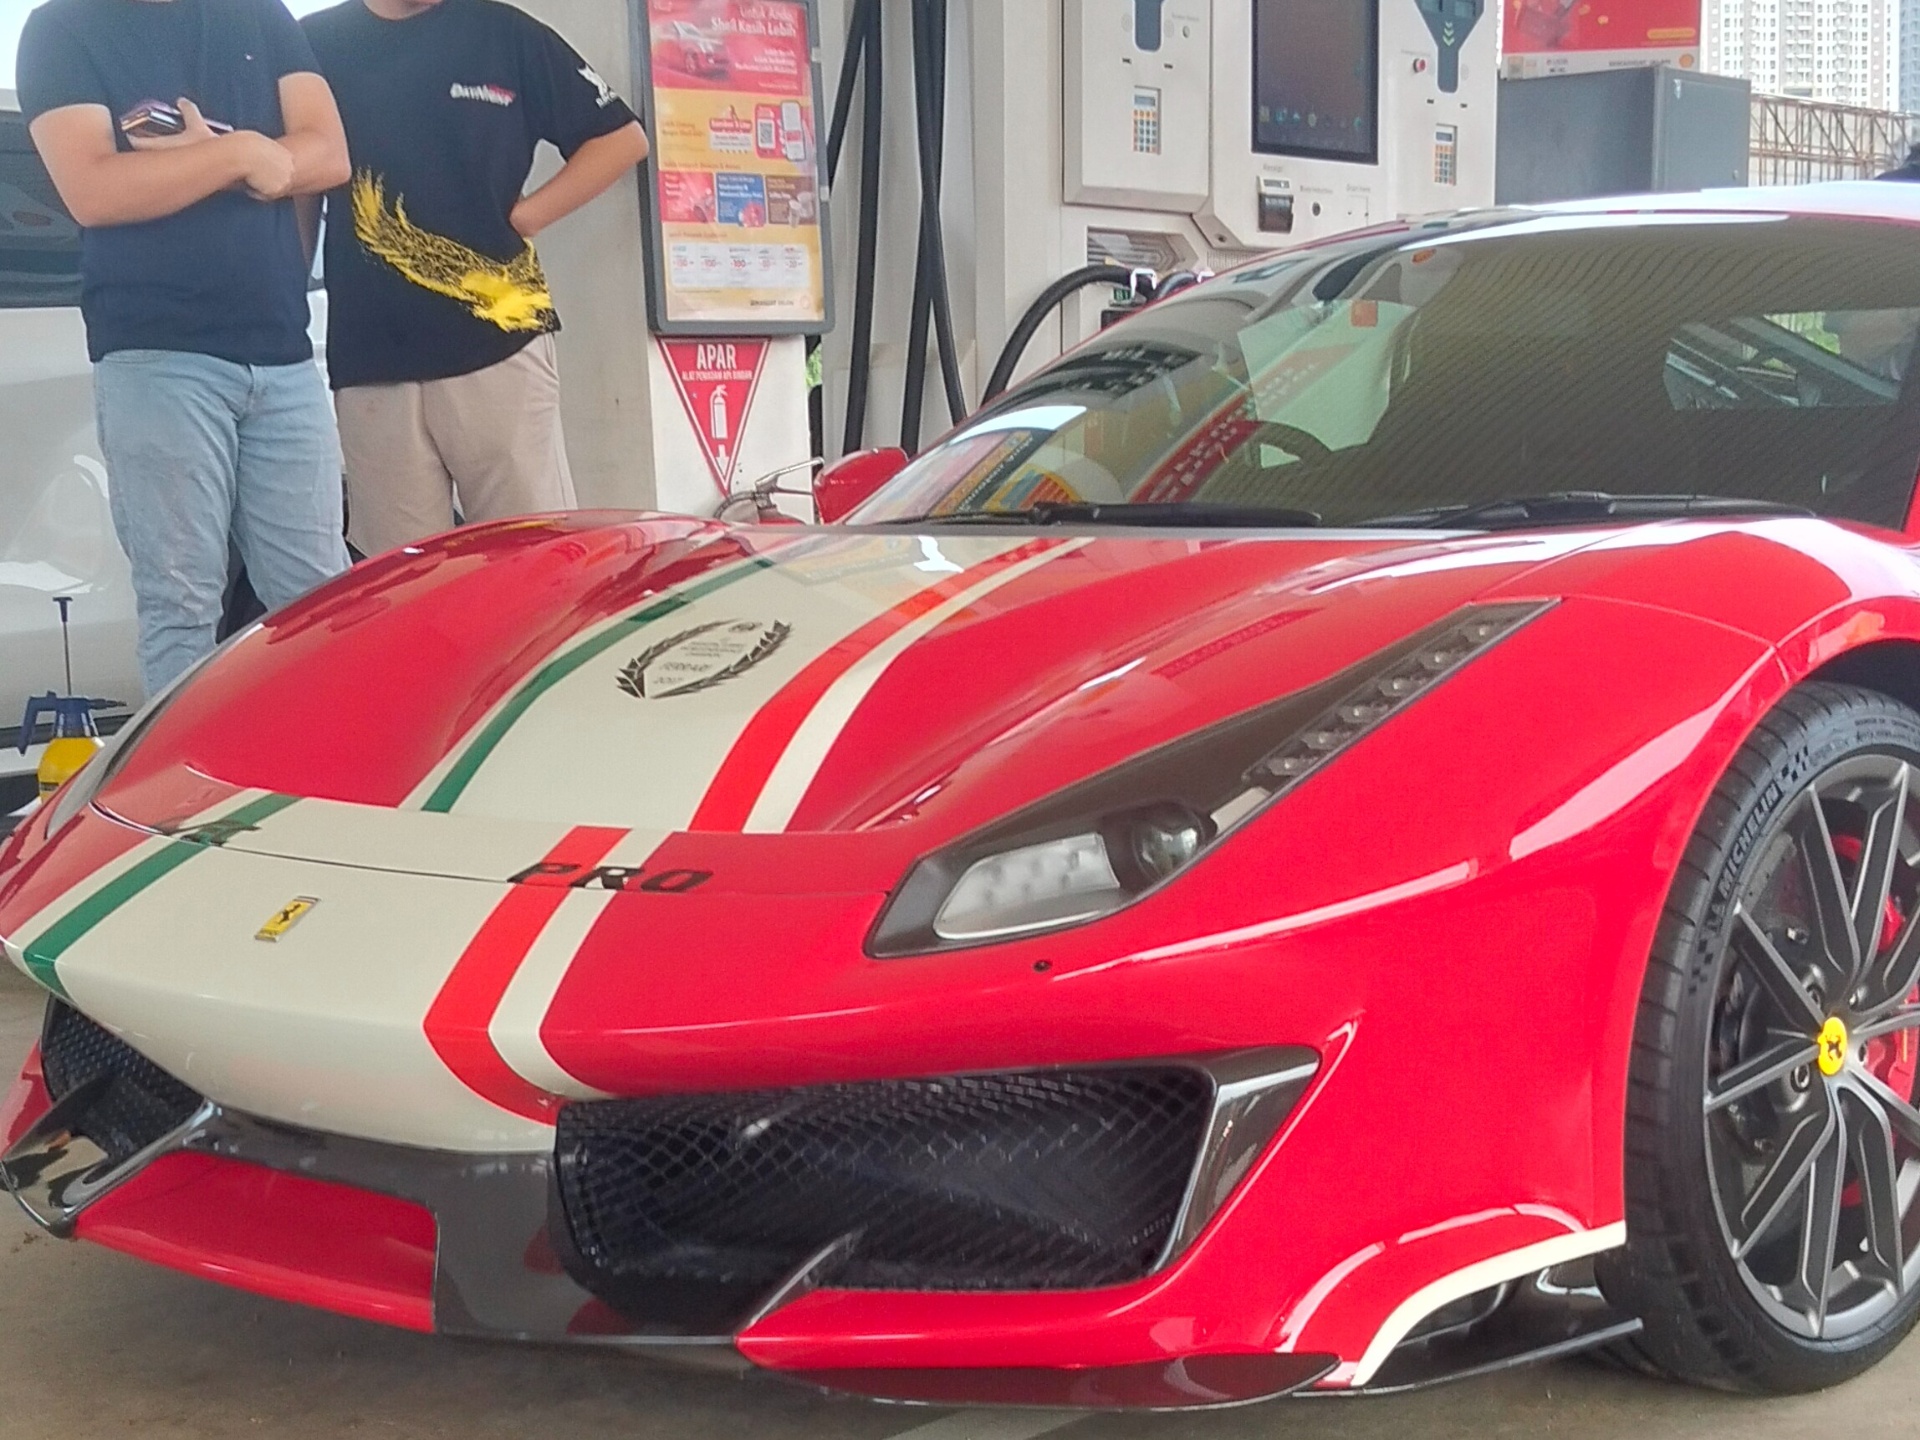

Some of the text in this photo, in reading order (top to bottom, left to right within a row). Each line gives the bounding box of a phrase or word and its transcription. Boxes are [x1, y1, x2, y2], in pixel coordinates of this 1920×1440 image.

[696, 343, 737, 370] APAR
[1716, 778, 1784, 900] MICHELIN
[507, 862, 714, 893] PRO
